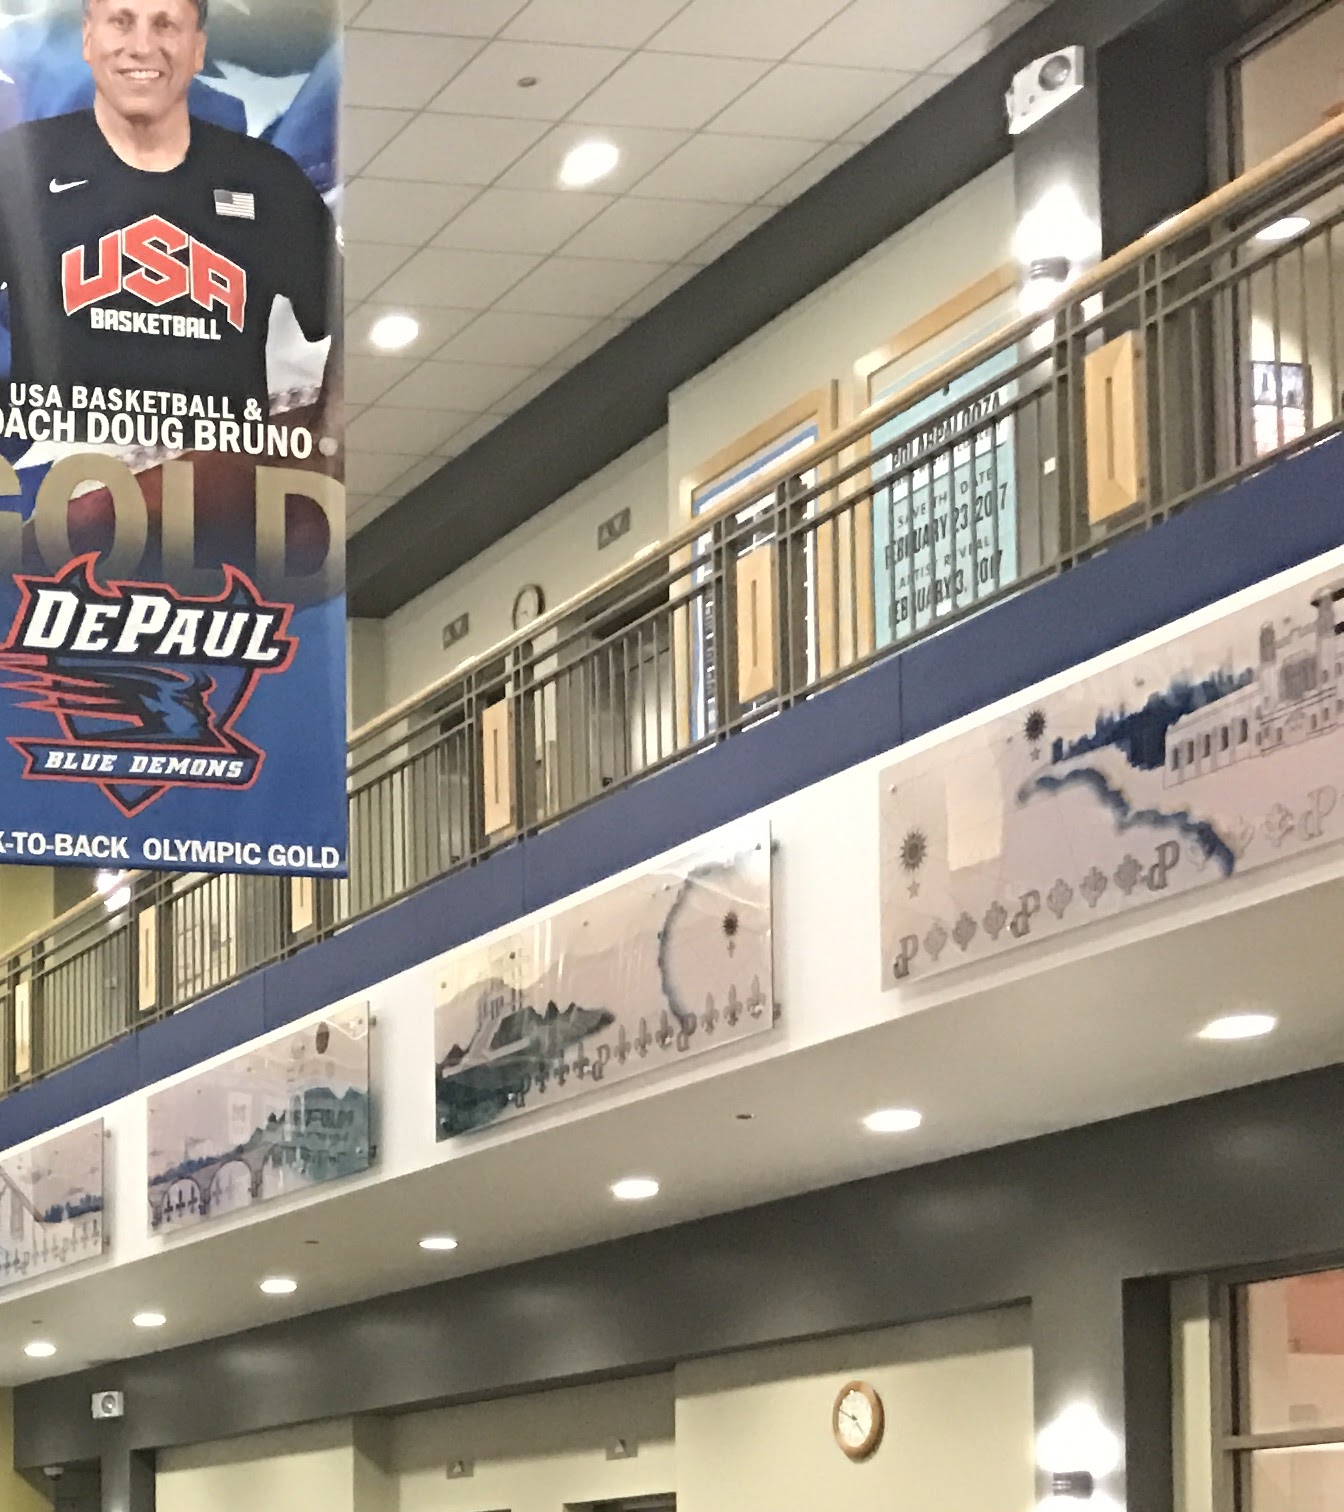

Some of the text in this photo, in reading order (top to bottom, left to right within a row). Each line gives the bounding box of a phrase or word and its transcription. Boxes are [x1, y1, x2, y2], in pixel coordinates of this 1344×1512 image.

[61, 213, 248, 333] USA
[90, 306, 222, 341] BASKETBALL
[9, 382, 263, 423] USA BASKETBALL &
[86, 411, 185, 451] DOUG
[193, 418, 313, 460] BRUNO
[960, 469, 993, 496] DTE
[974, 481, 1009, 523] 207
[44, 750, 245, 780] BLUE DEMONS
[142, 836, 263, 867] OLYMPIC
[267, 844, 340, 870] GOLD
